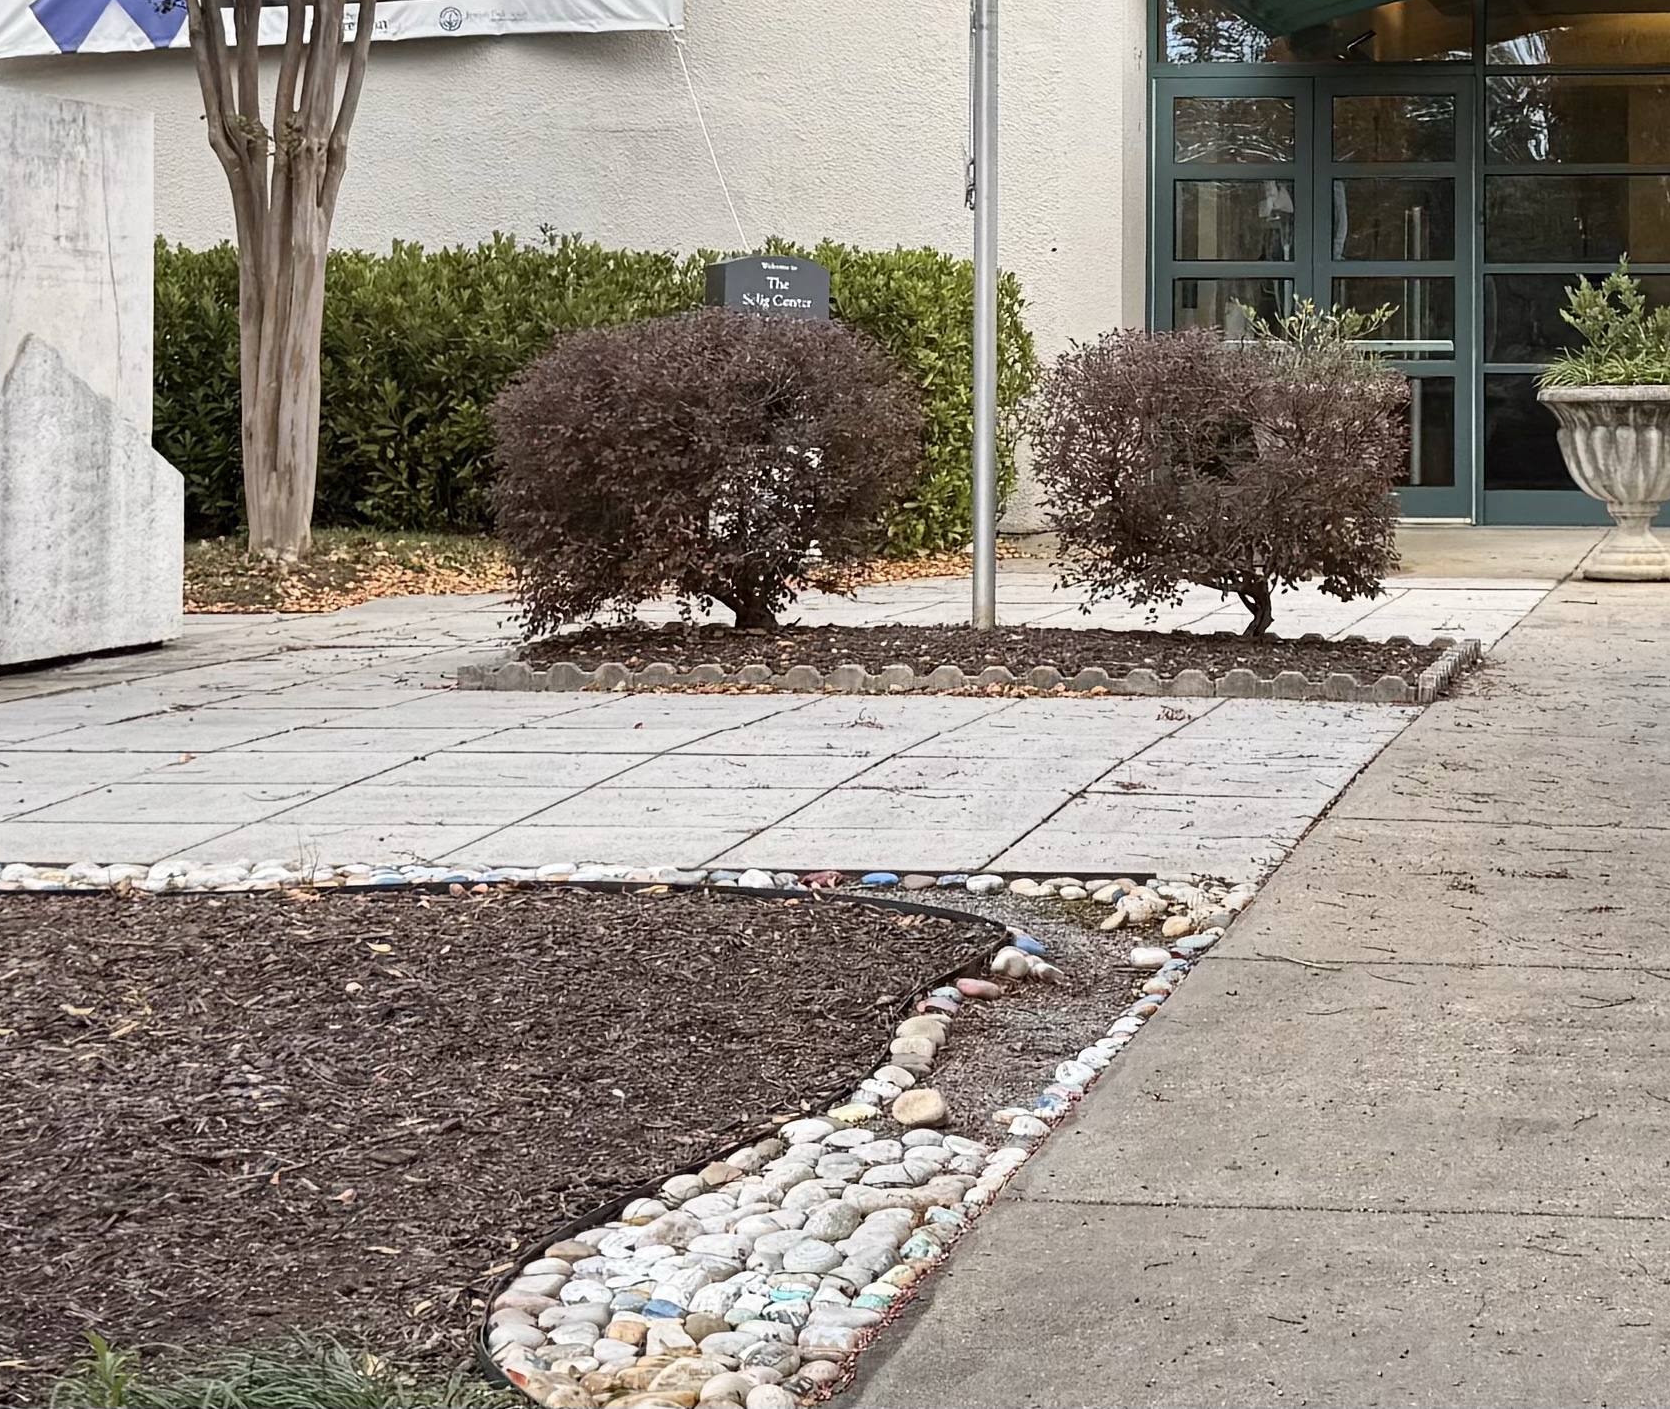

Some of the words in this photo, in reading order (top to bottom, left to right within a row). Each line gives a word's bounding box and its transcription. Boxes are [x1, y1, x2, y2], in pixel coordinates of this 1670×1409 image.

[766, 276, 790, 290] The
[742, 292, 770, 309] Selig
[772, 294, 812, 308] Center
